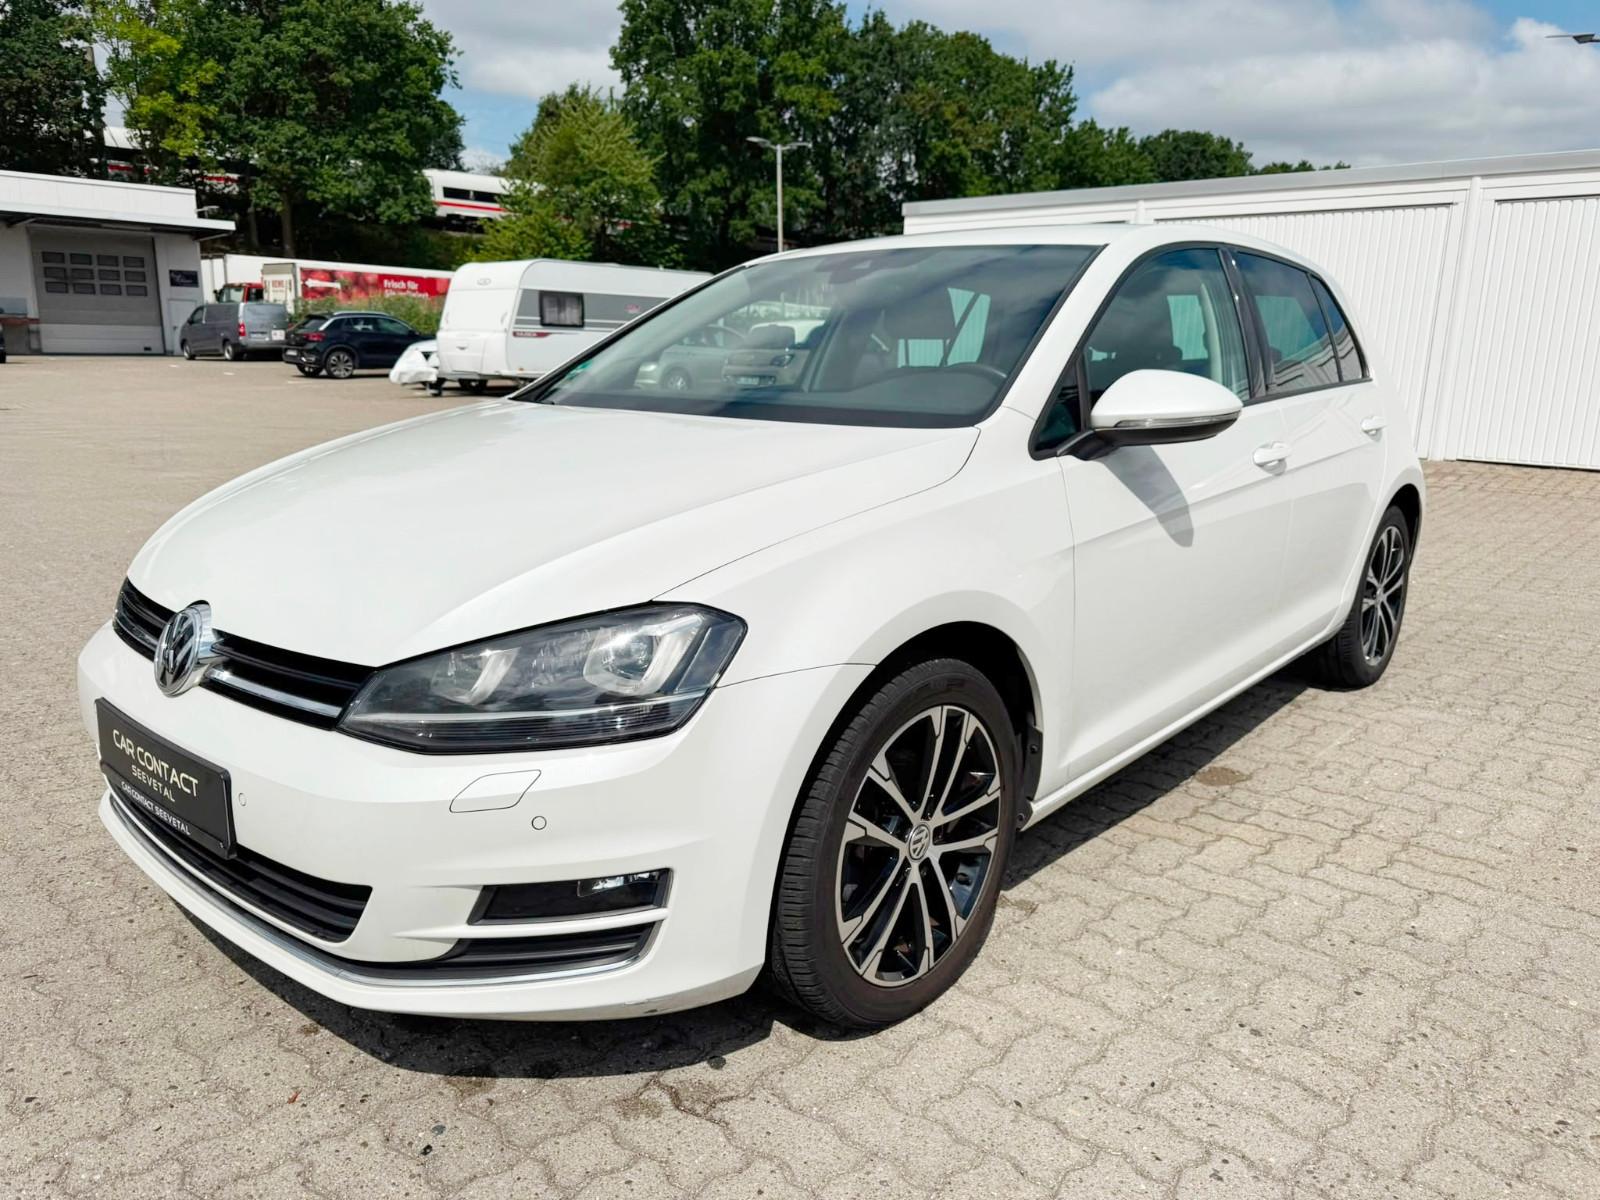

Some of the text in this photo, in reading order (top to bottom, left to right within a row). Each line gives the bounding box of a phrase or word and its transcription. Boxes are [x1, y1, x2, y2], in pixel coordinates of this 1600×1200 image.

[113, 729, 199, 797] CAR CONTACT
[131, 764, 175, 802] SEEVETAL
[154, 805, 191, 836] SEEVETAL
